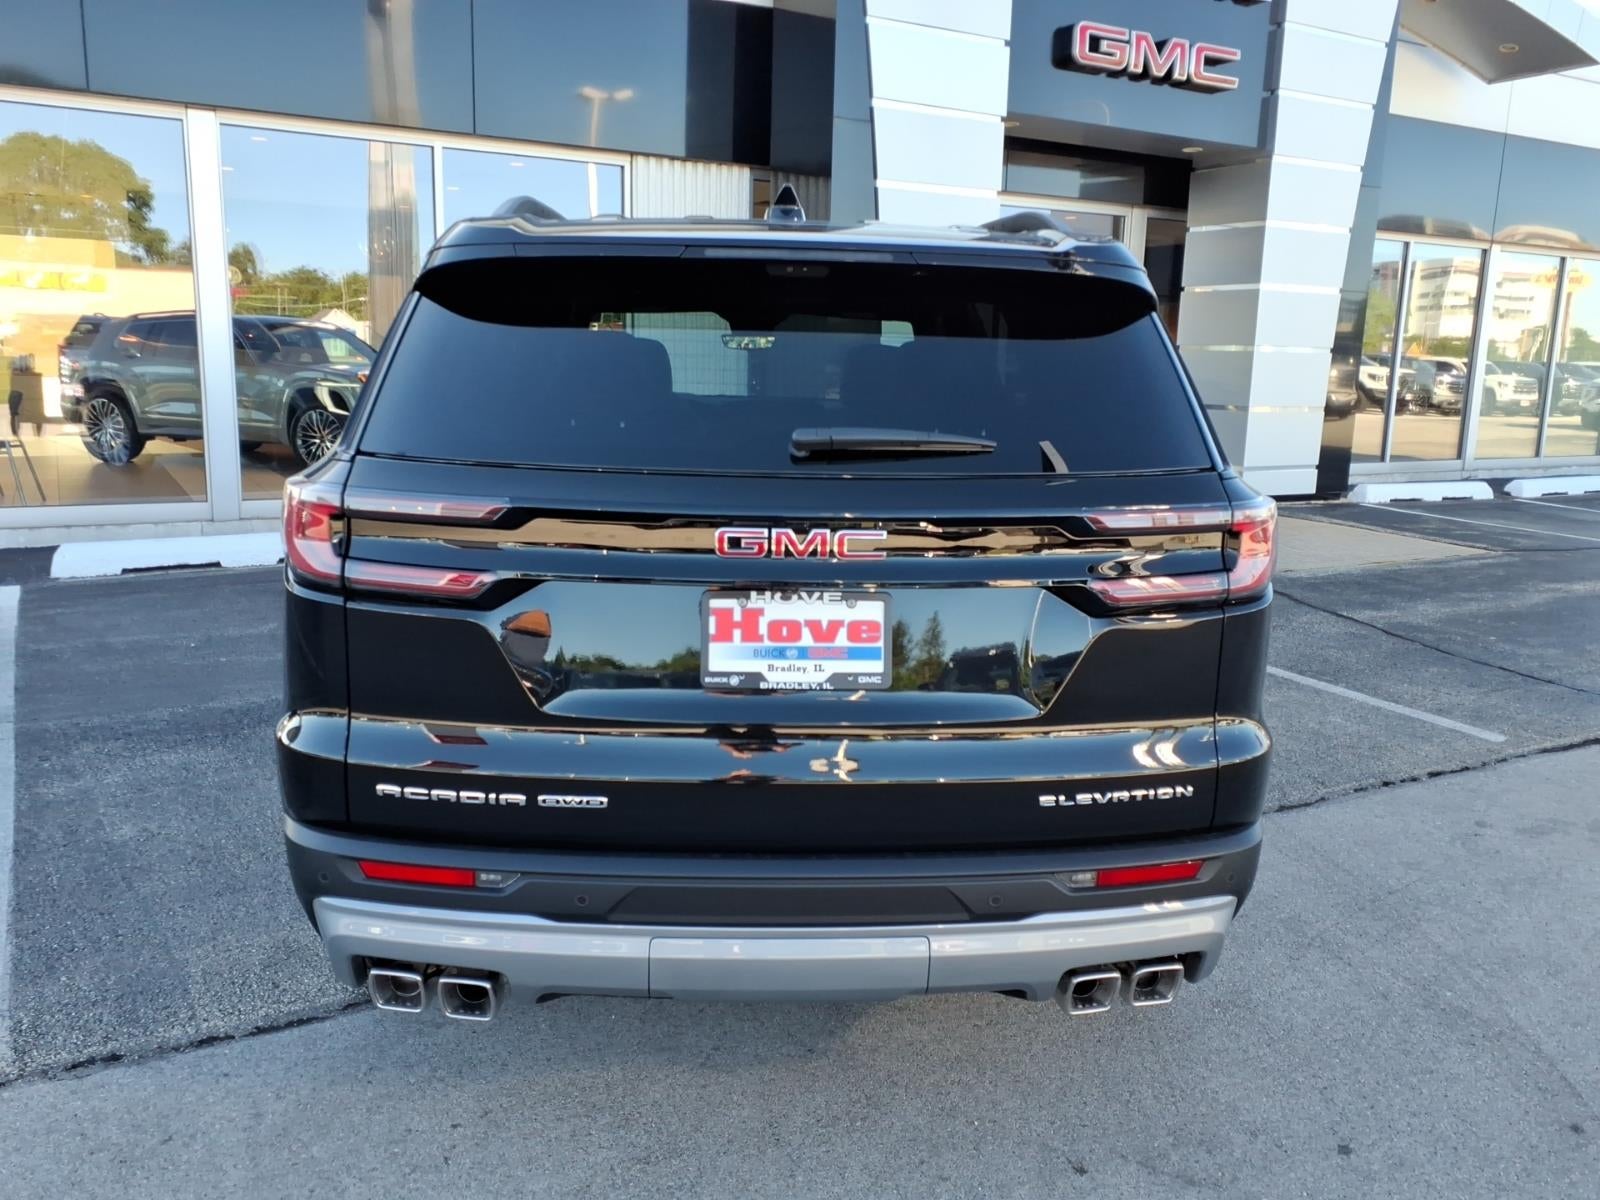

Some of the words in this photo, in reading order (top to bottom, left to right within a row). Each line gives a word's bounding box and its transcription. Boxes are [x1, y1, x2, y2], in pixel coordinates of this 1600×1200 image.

[1074, 20, 1241, 89] GMC
[714, 526, 888, 560] GMC
[750, 591, 844, 605] HOVE
[709, 607, 882, 644] Hove
[753, 648, 785, 658] BUICK
[814, 664, 825, 672] IL
[823, 681, 834, 690] IL
[858, 675, 882, 683] GMC
[376, 784, 526, 806] ACADIA
[537, 794, 608, 808] AWD
[1038, 785, 1194, 807] ELEVATION
